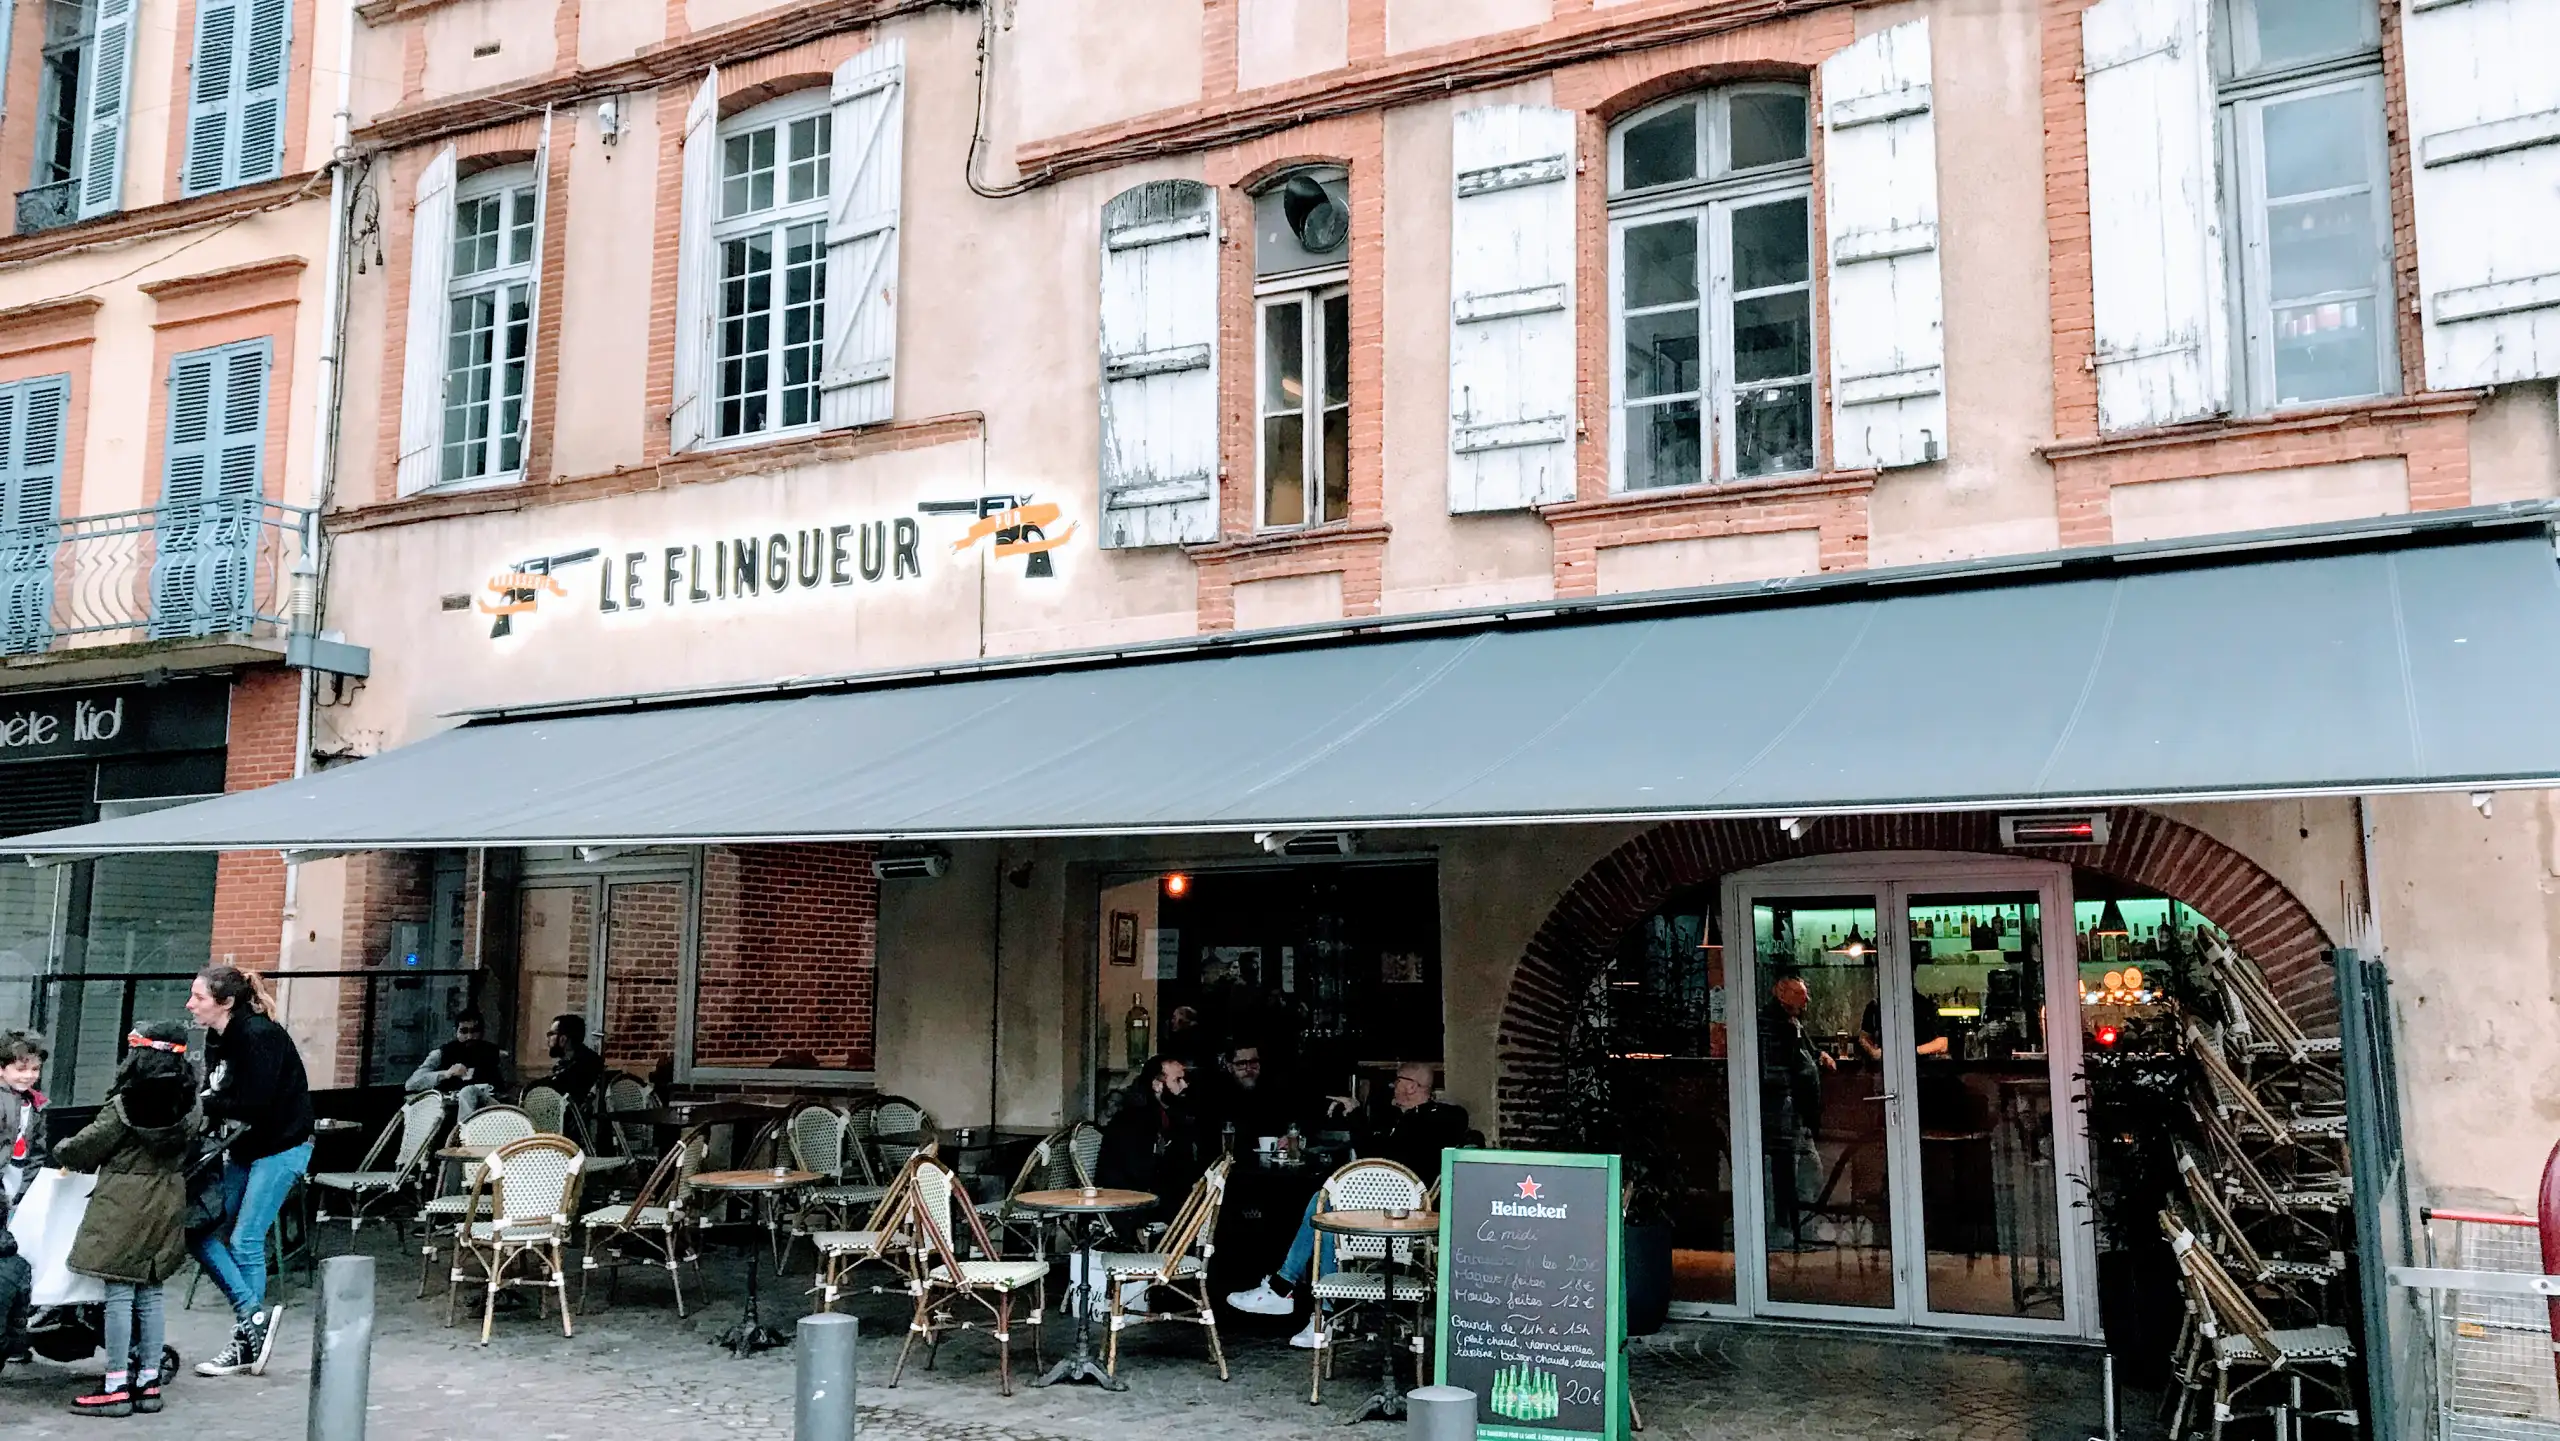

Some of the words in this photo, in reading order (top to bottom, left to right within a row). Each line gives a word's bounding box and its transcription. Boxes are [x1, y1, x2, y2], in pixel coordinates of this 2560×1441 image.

[995, 510, 1021, 529] PUB
[599, 551, 646, 613] LE
[663, 517, 922, 605] FLINGUEUR
[0, 711, 59, 747] èle
[73, 697, 124, 741] Kid
[1490, 1200, 1567, 1219] Heineken
[1500, 1226, 1538, 1241] midi
[1454, 1289, 1501, 1306] Moules
[1451, 1314, 1494, 1333] Brunch
[1500, 1322, 1516, 1335] de
[1563, 1321, 1591, 1336] 15h
[1563, 1379, 1602, 1405] 20€
